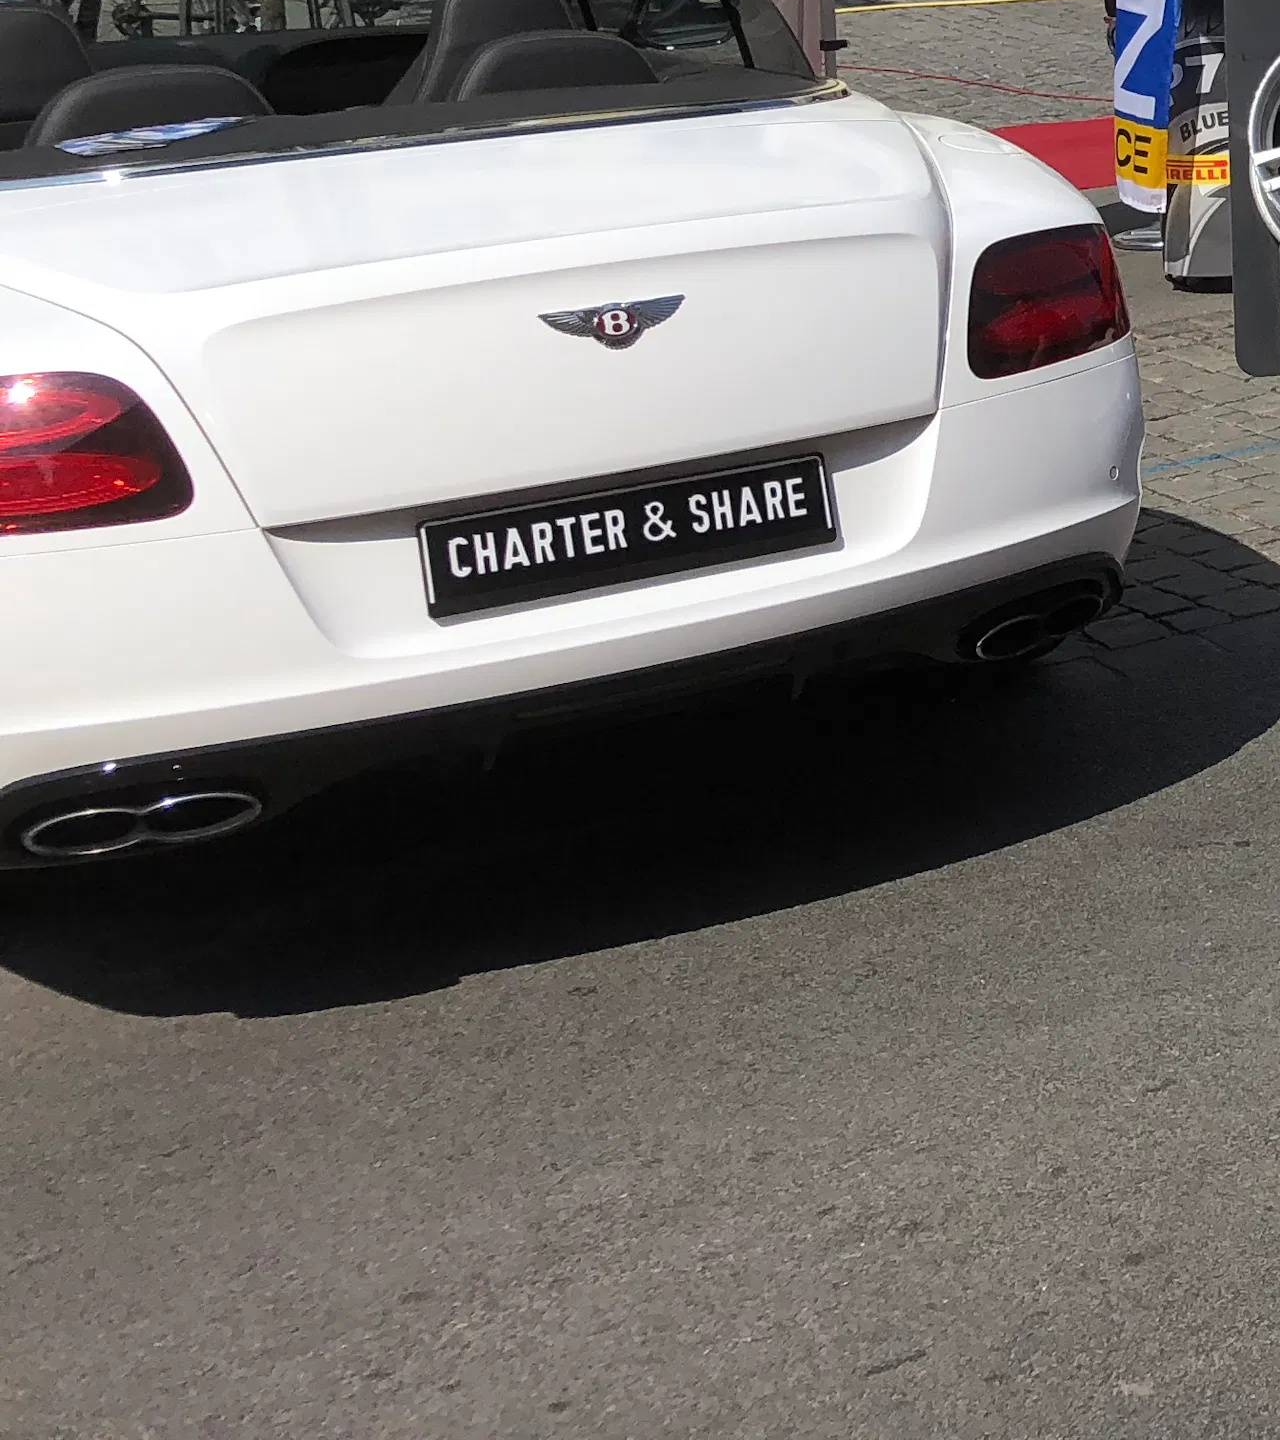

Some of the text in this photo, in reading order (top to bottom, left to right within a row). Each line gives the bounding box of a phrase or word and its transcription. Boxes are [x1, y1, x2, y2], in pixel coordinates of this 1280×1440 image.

[603, 309, 631, 336] B
[447, 476, 809, 579] CHARTER & SHARE
